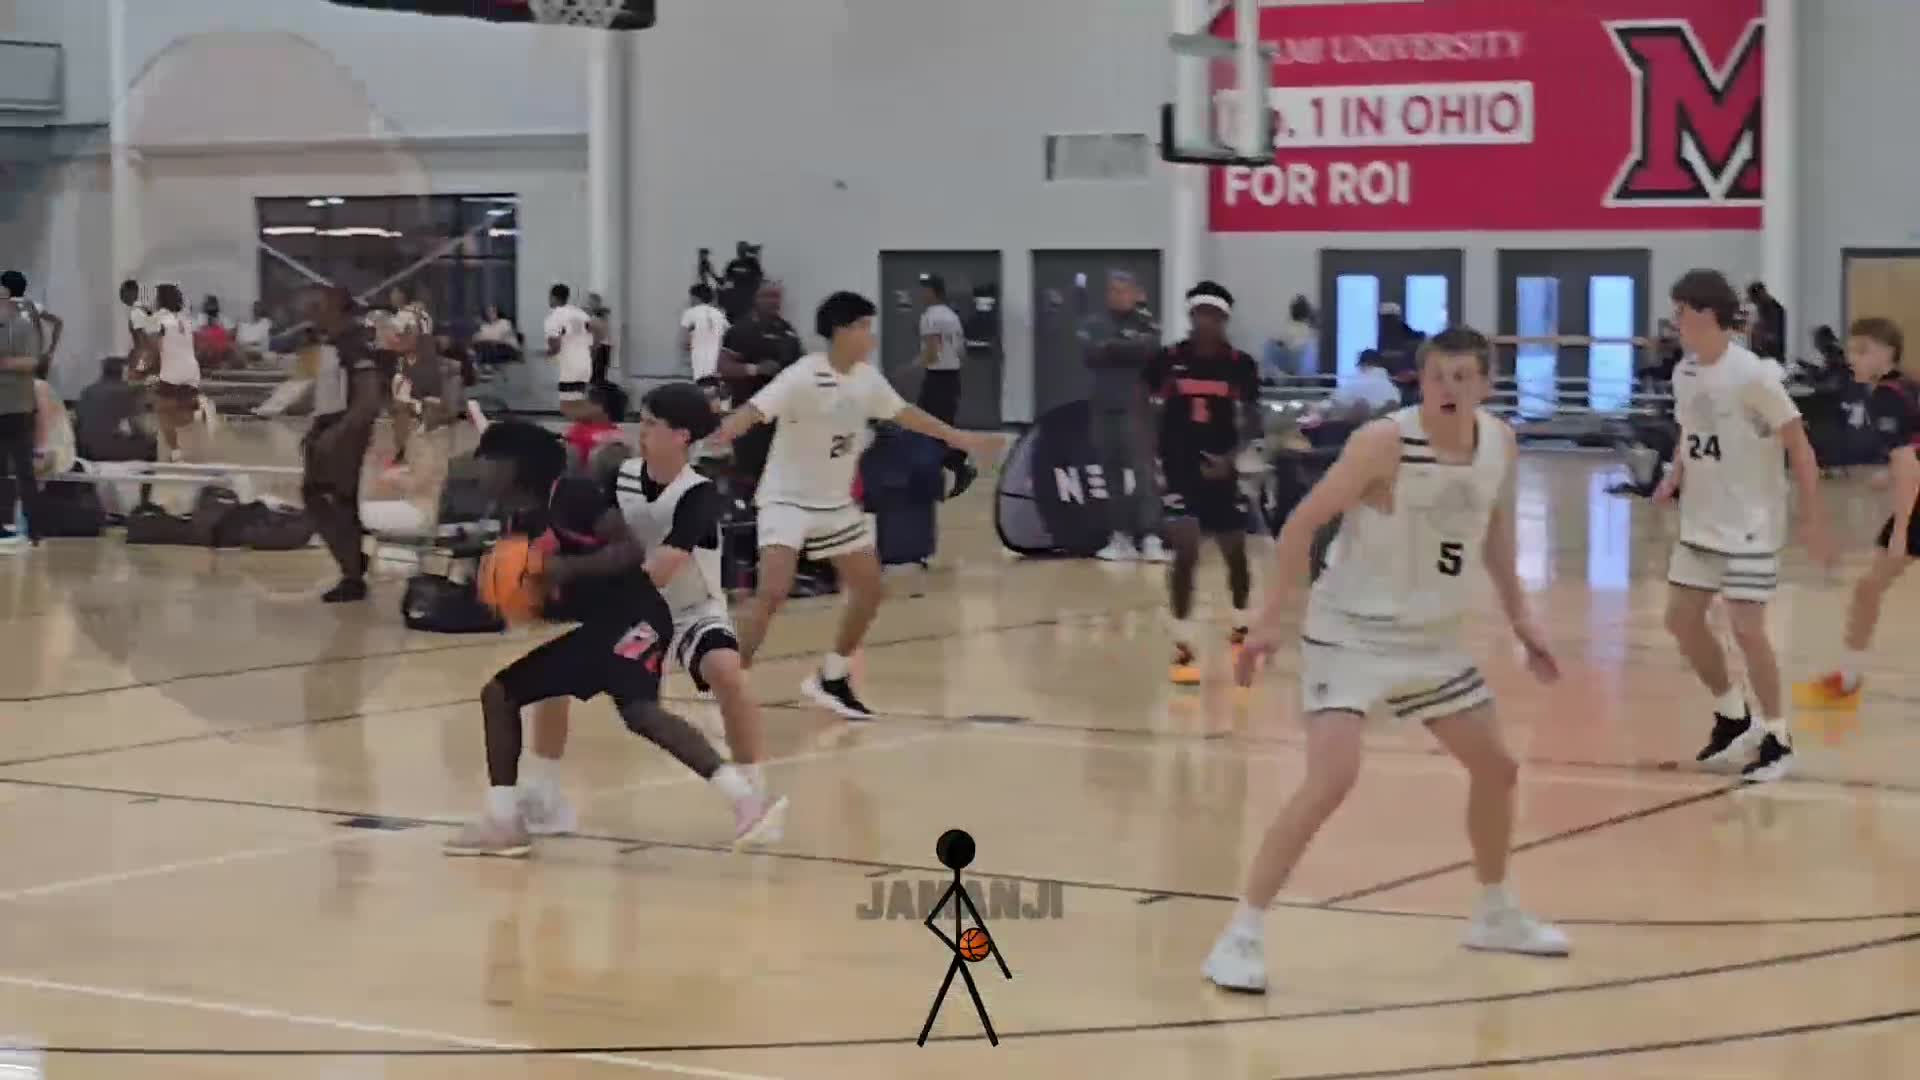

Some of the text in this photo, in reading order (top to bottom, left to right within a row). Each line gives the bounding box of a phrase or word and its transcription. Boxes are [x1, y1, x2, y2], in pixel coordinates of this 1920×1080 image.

[1330, 31, 1524, 63] UNIVERSITY
[1311, 97, 1324, 138] 1
[1341, 95, 1386, 137] IN
[1401, 92, 1522, 135] OHIO
[1601, 18, 1764, 208] M
[1224, 160, 1411, 207] FOR ROI
[1687, 433, 1722, 461] 24
[1437, 541, 1464, 577] 5
